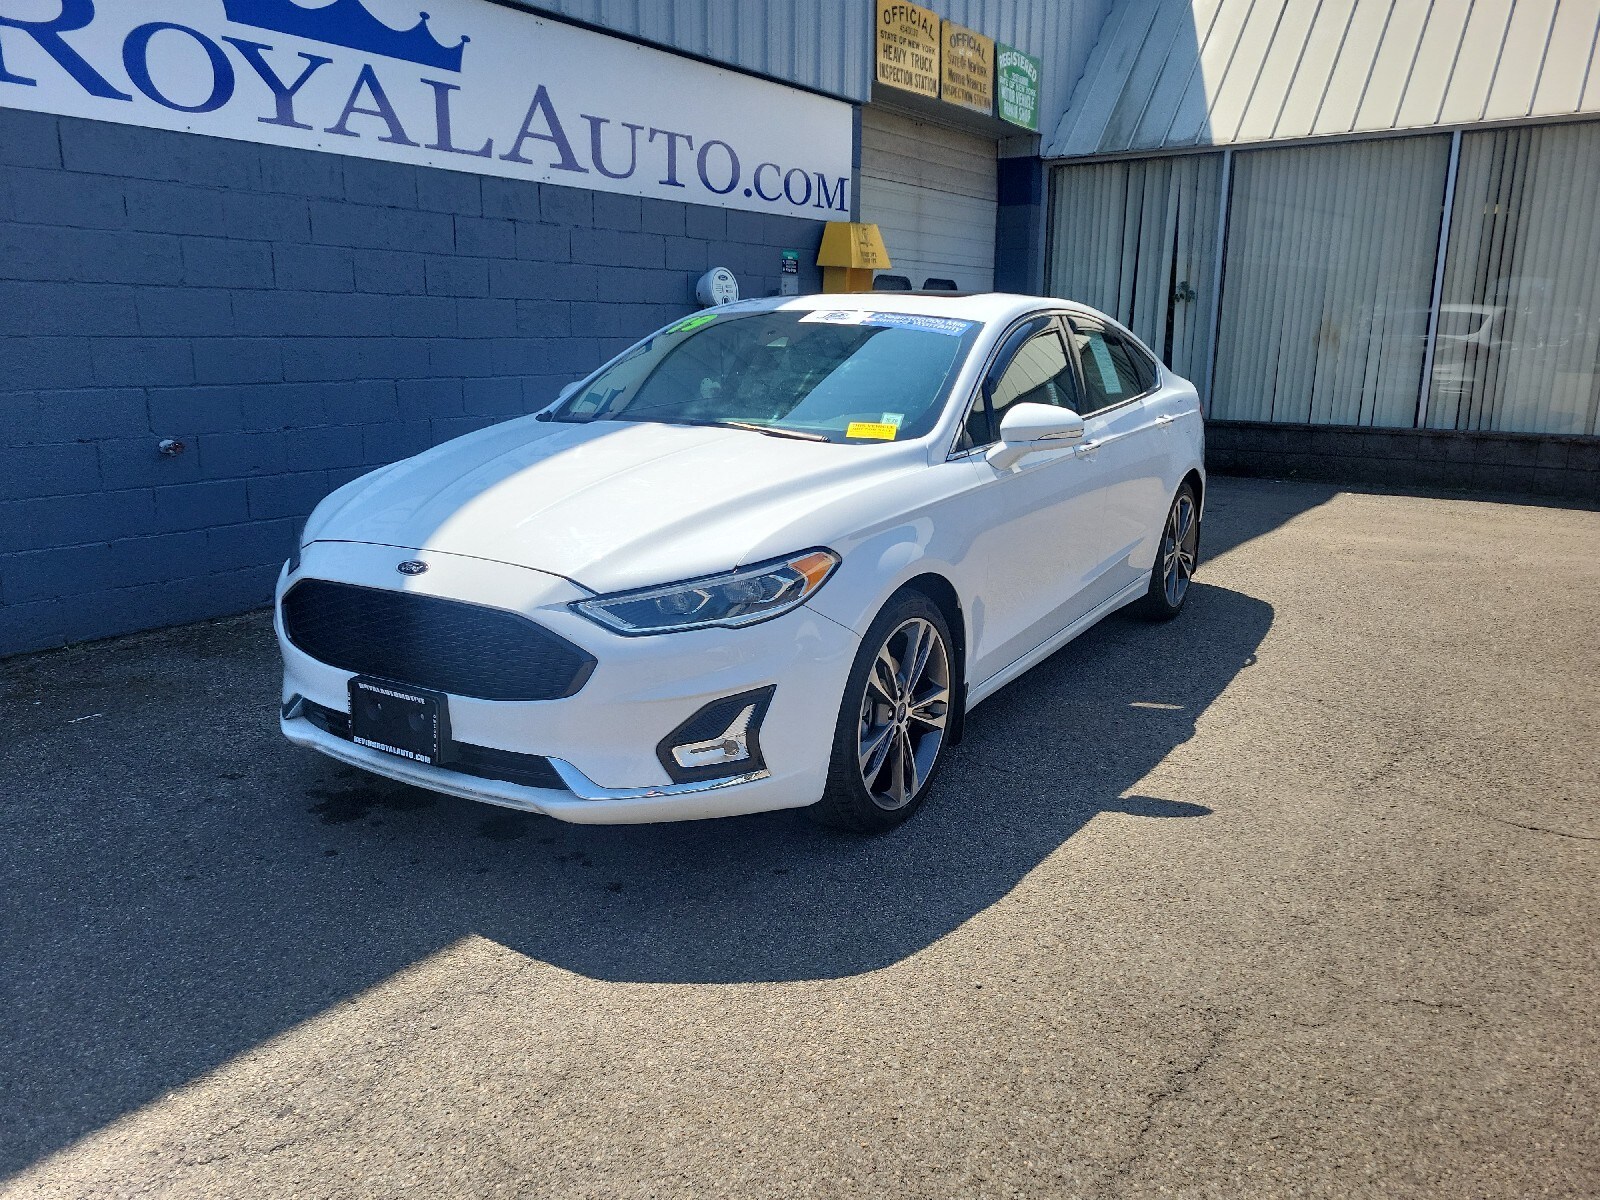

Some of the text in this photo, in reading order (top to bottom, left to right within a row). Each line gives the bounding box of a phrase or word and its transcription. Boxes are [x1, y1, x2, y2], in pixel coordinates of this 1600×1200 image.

[883, 5, 935, 41] OFFICIAL
[880, 29, 897, 42] STATE
[898, 36, 907, 46] OF
[907, 39, 920, 50] NEW
[922, 44, 936, 55] YORK
[883, 42, 933, 73] HEAVY TRUCK
[950, 33, 986, 64] OFFICIAL
[879, 62, 938, 93] INSPECTION STATION
[999, 51, 1037, 83] REGISTERED
[943, 83, 973, 104] INSPECTION
